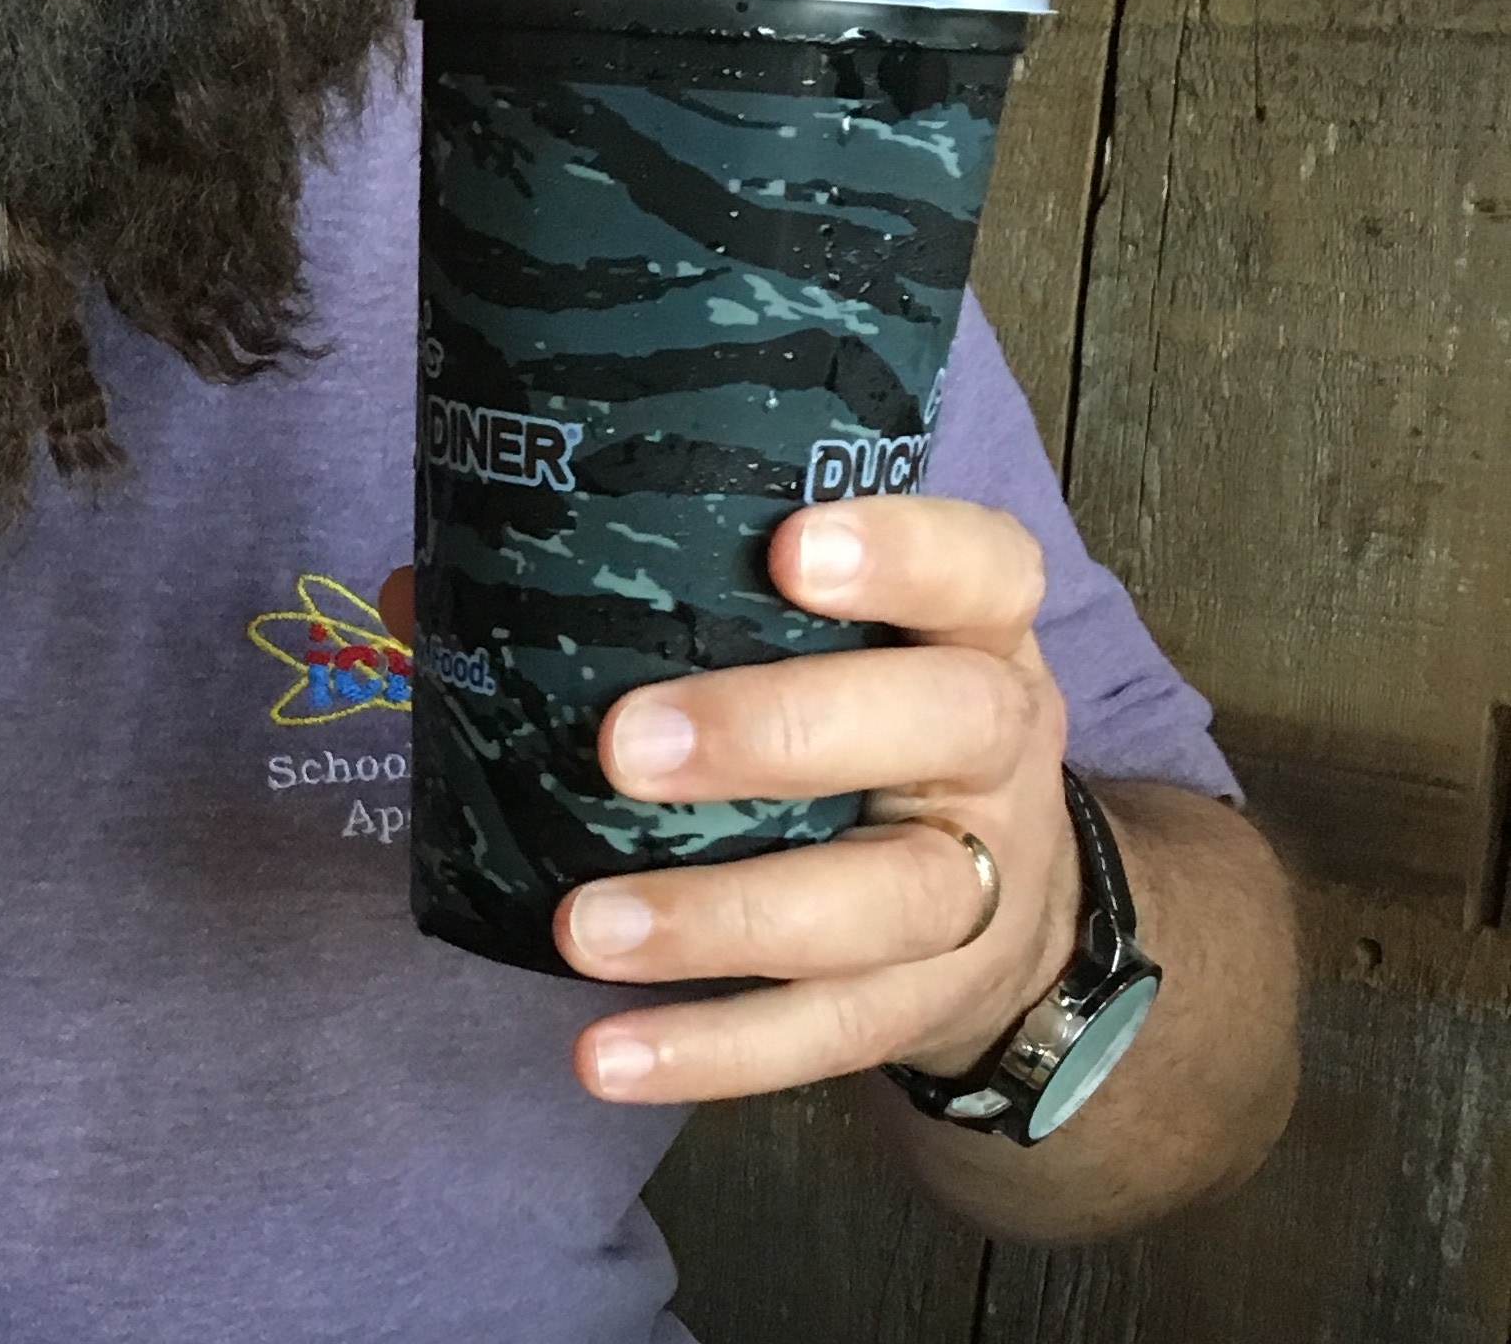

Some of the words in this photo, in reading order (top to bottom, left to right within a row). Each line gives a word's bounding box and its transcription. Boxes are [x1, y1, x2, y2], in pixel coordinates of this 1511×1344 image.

[427, 395, 575, 491] DINER
[268, 751, 411, 791] Schoo
[342, 799, 411, 844] Ap
